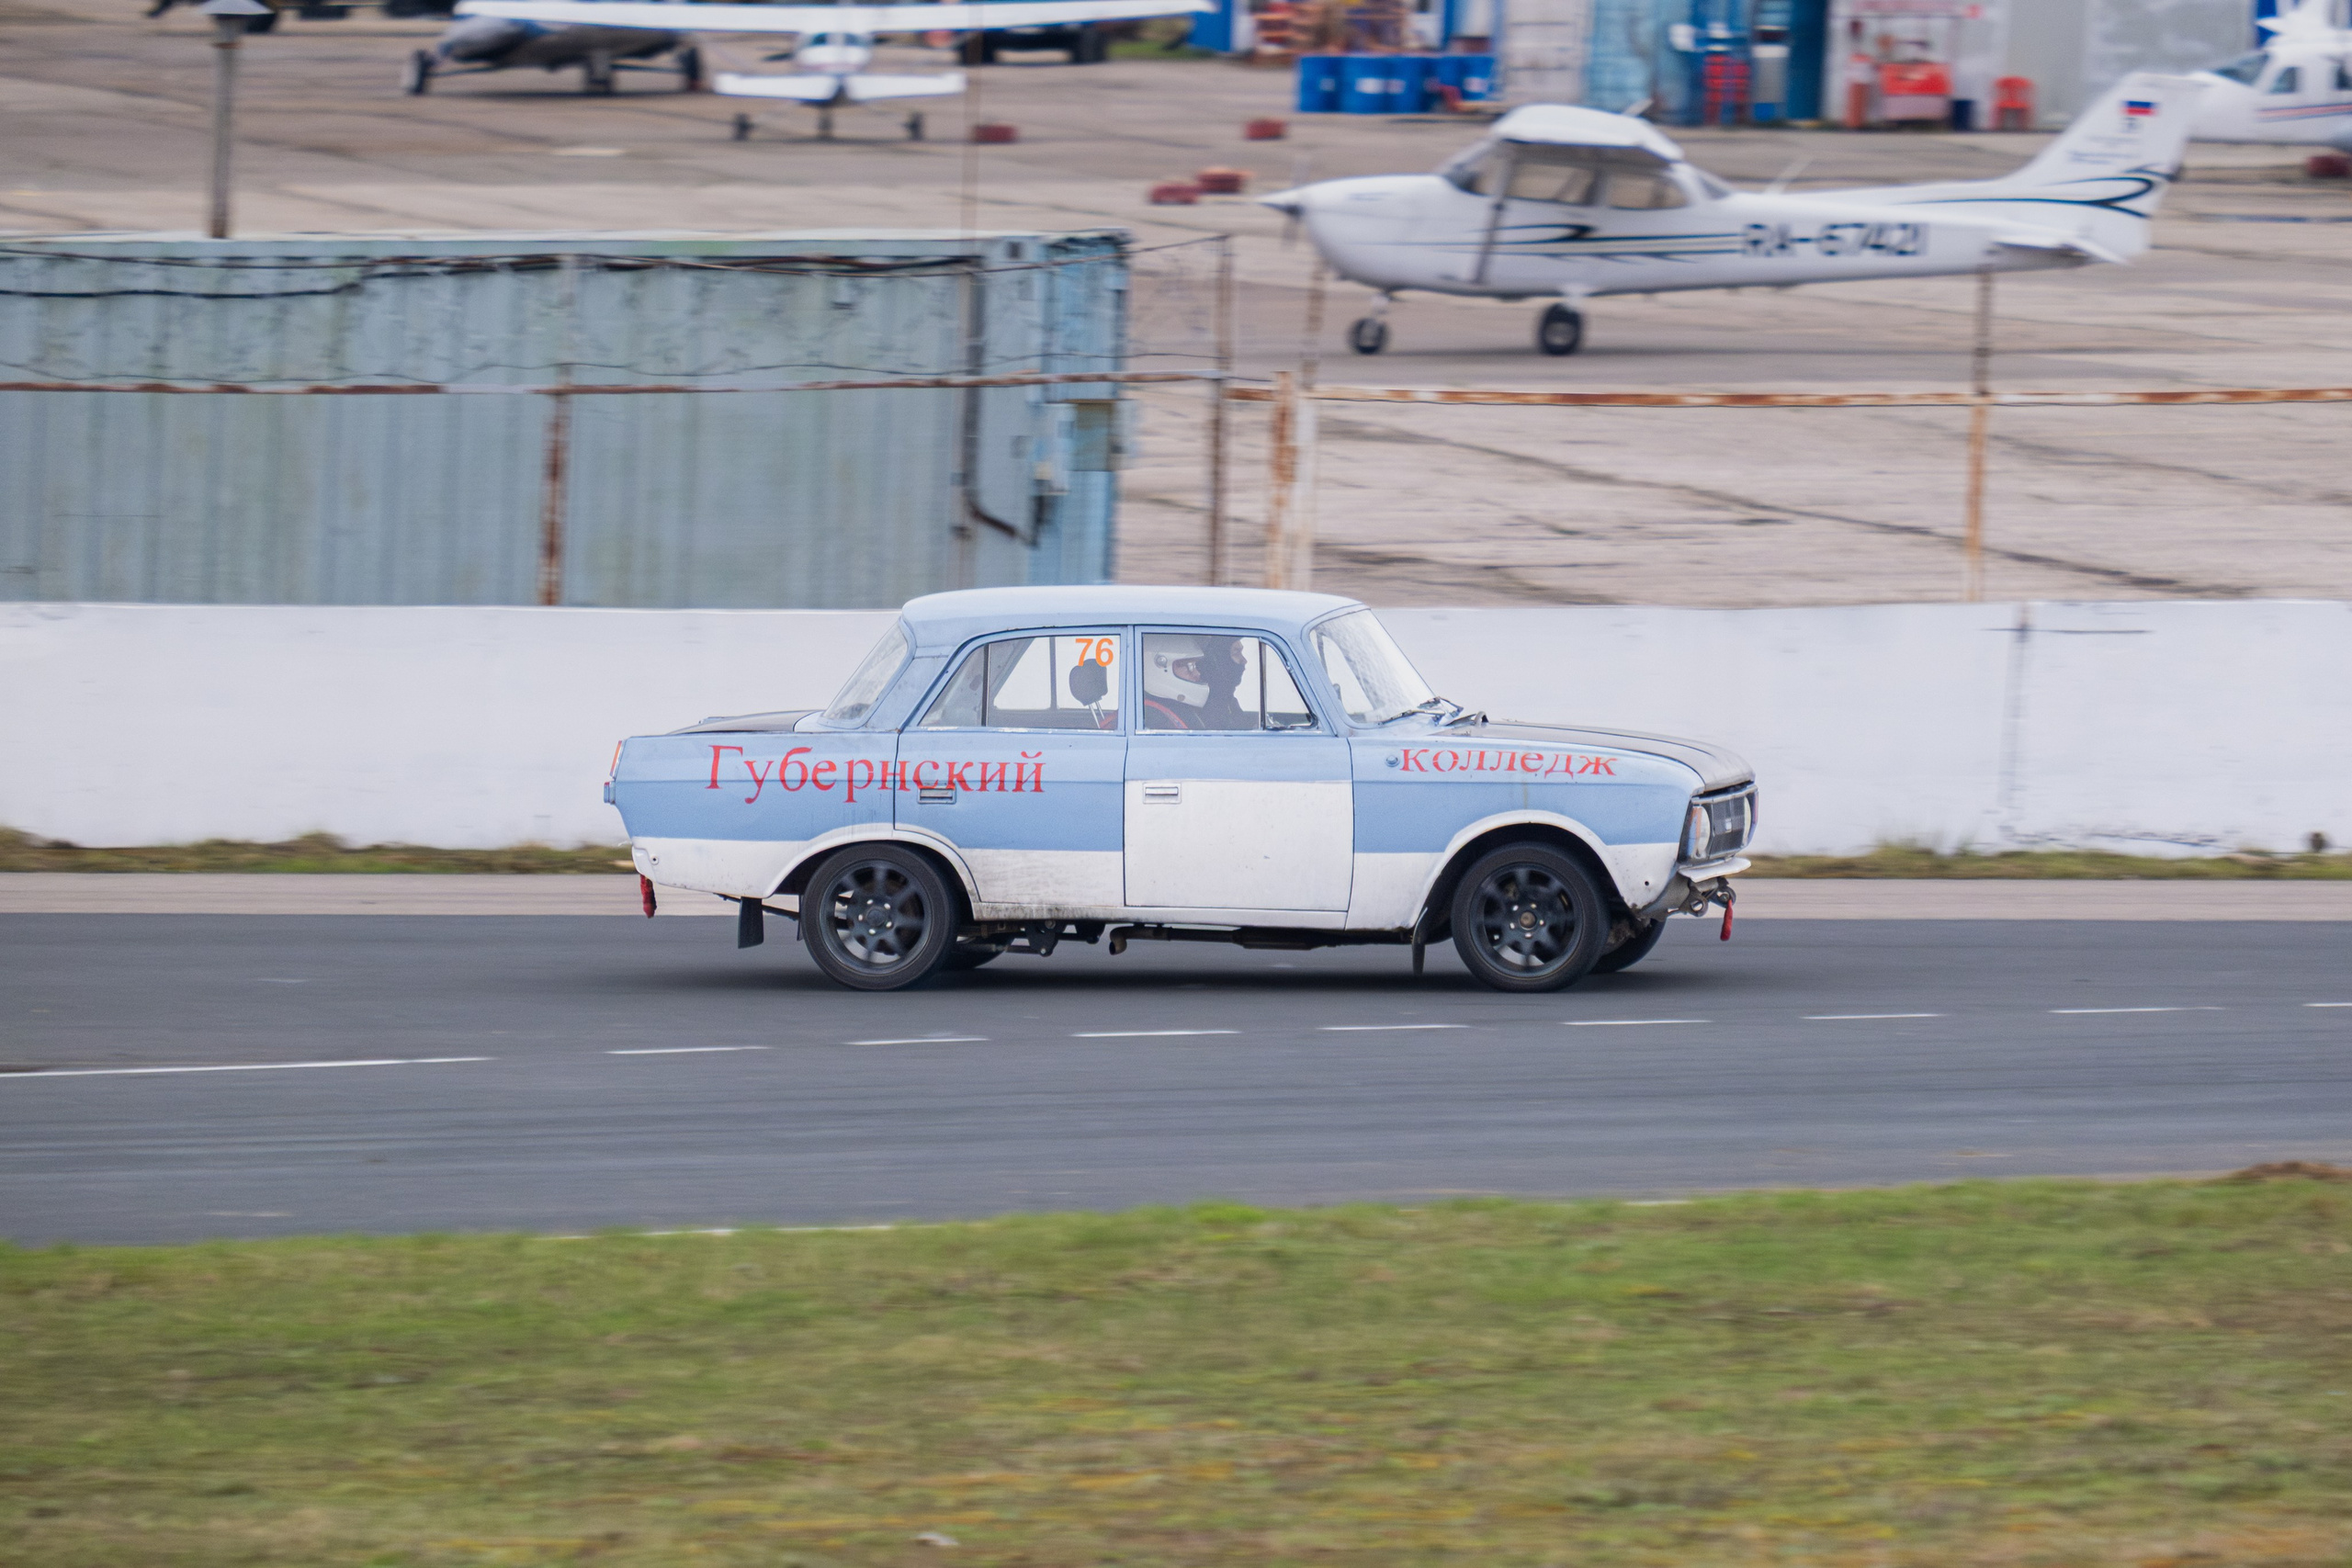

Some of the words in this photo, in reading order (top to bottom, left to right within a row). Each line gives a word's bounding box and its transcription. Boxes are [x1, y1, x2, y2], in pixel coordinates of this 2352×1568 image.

[1075, 637, 1114, 667] 76
[705, 744, 1046, 805] Губернский
[1399, 748, 1618, 779] колледж
